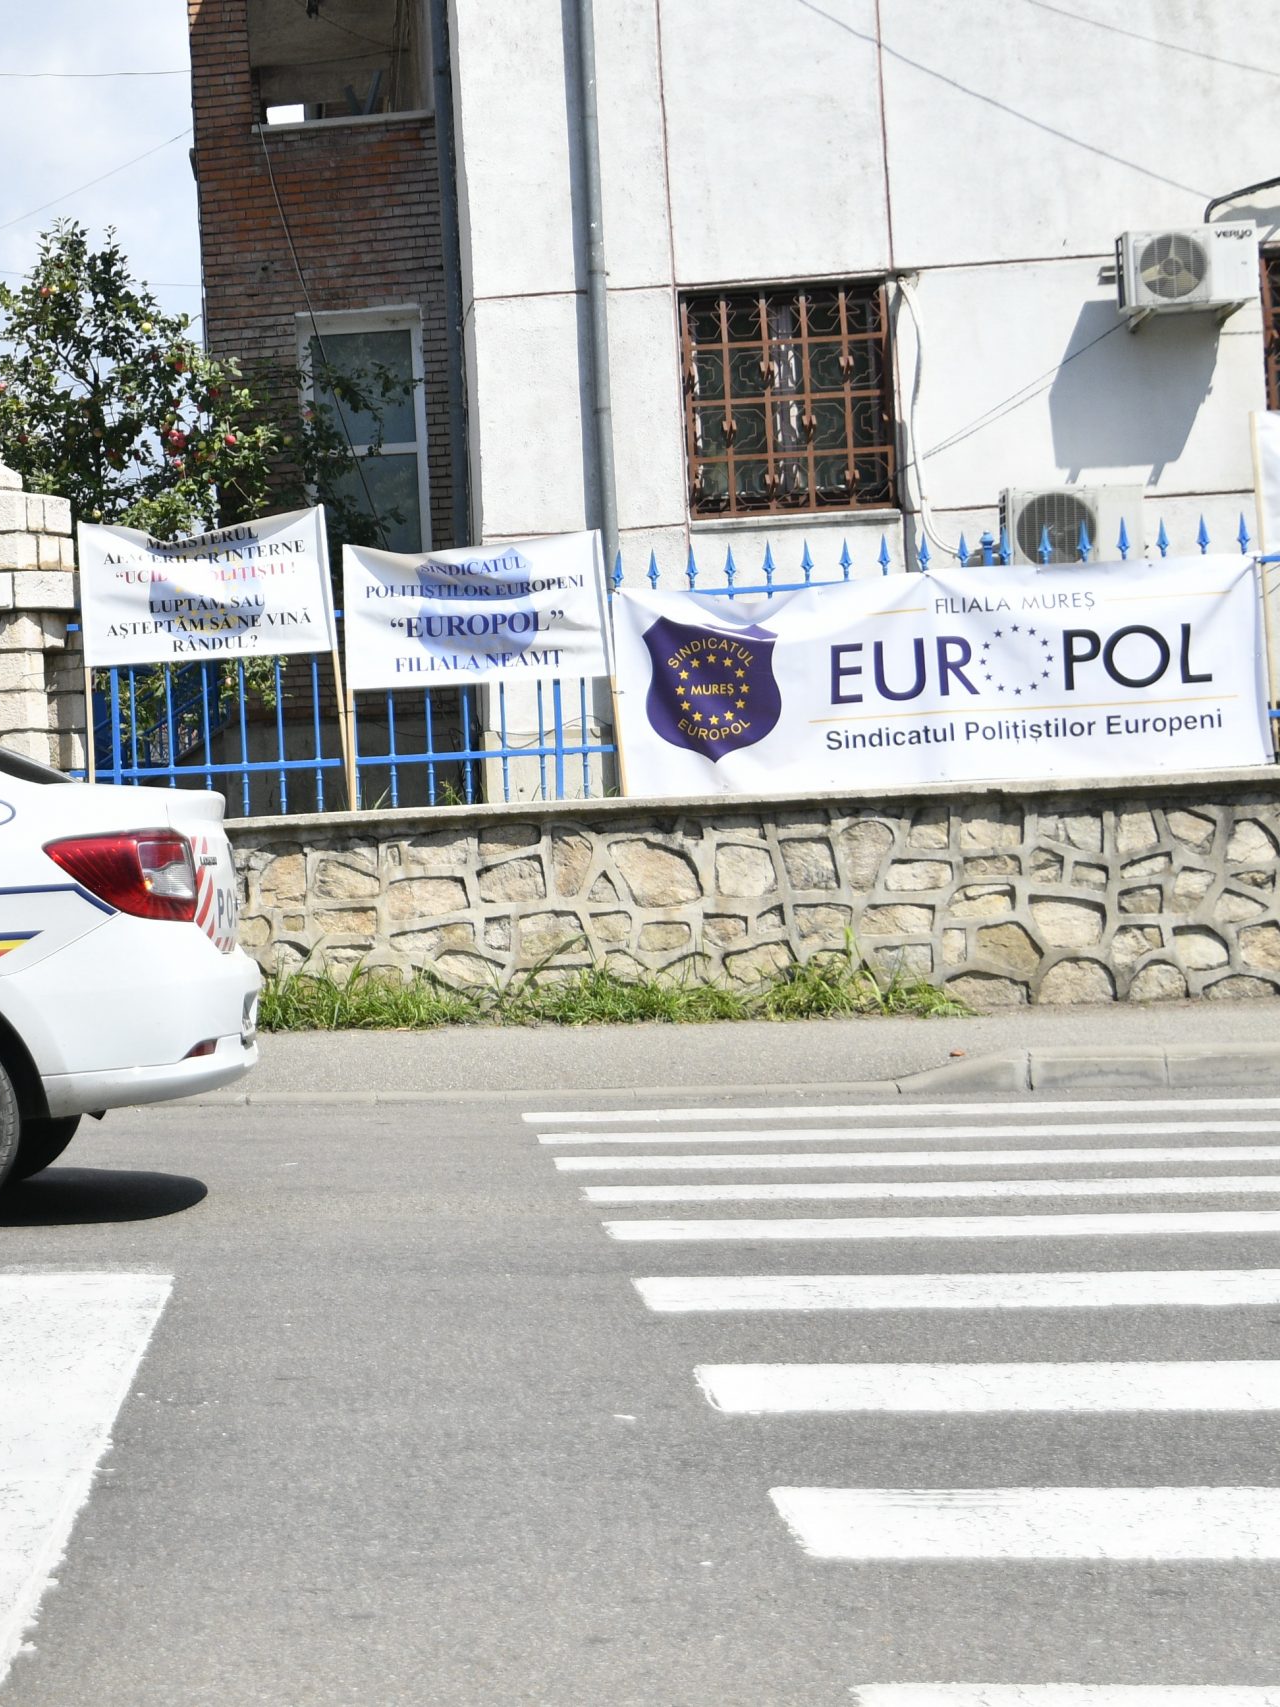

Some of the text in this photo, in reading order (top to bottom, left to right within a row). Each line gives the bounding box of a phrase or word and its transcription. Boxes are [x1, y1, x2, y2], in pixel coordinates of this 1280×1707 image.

[225, 539, 305, 564] INTERNE
[420, 556, 526, 576] SINDICATUL
[496, 574, 585, 596] EUROPENI
[230, 593, 265, 609] SAU
[935, 597, 1011, 614] FILIALA
[236, 614, 262, 629] NE
[266, 607, 312, 625] VINĂ
[395, 653, 480, 673] FILIALA
[667, 637, 754, 669] SINDICATUL
[677, 718, 752, 741] EUROPOL
[825, 722, 956, 751] Sindicatul
[1105, 708, 1224, 739] Europeni
